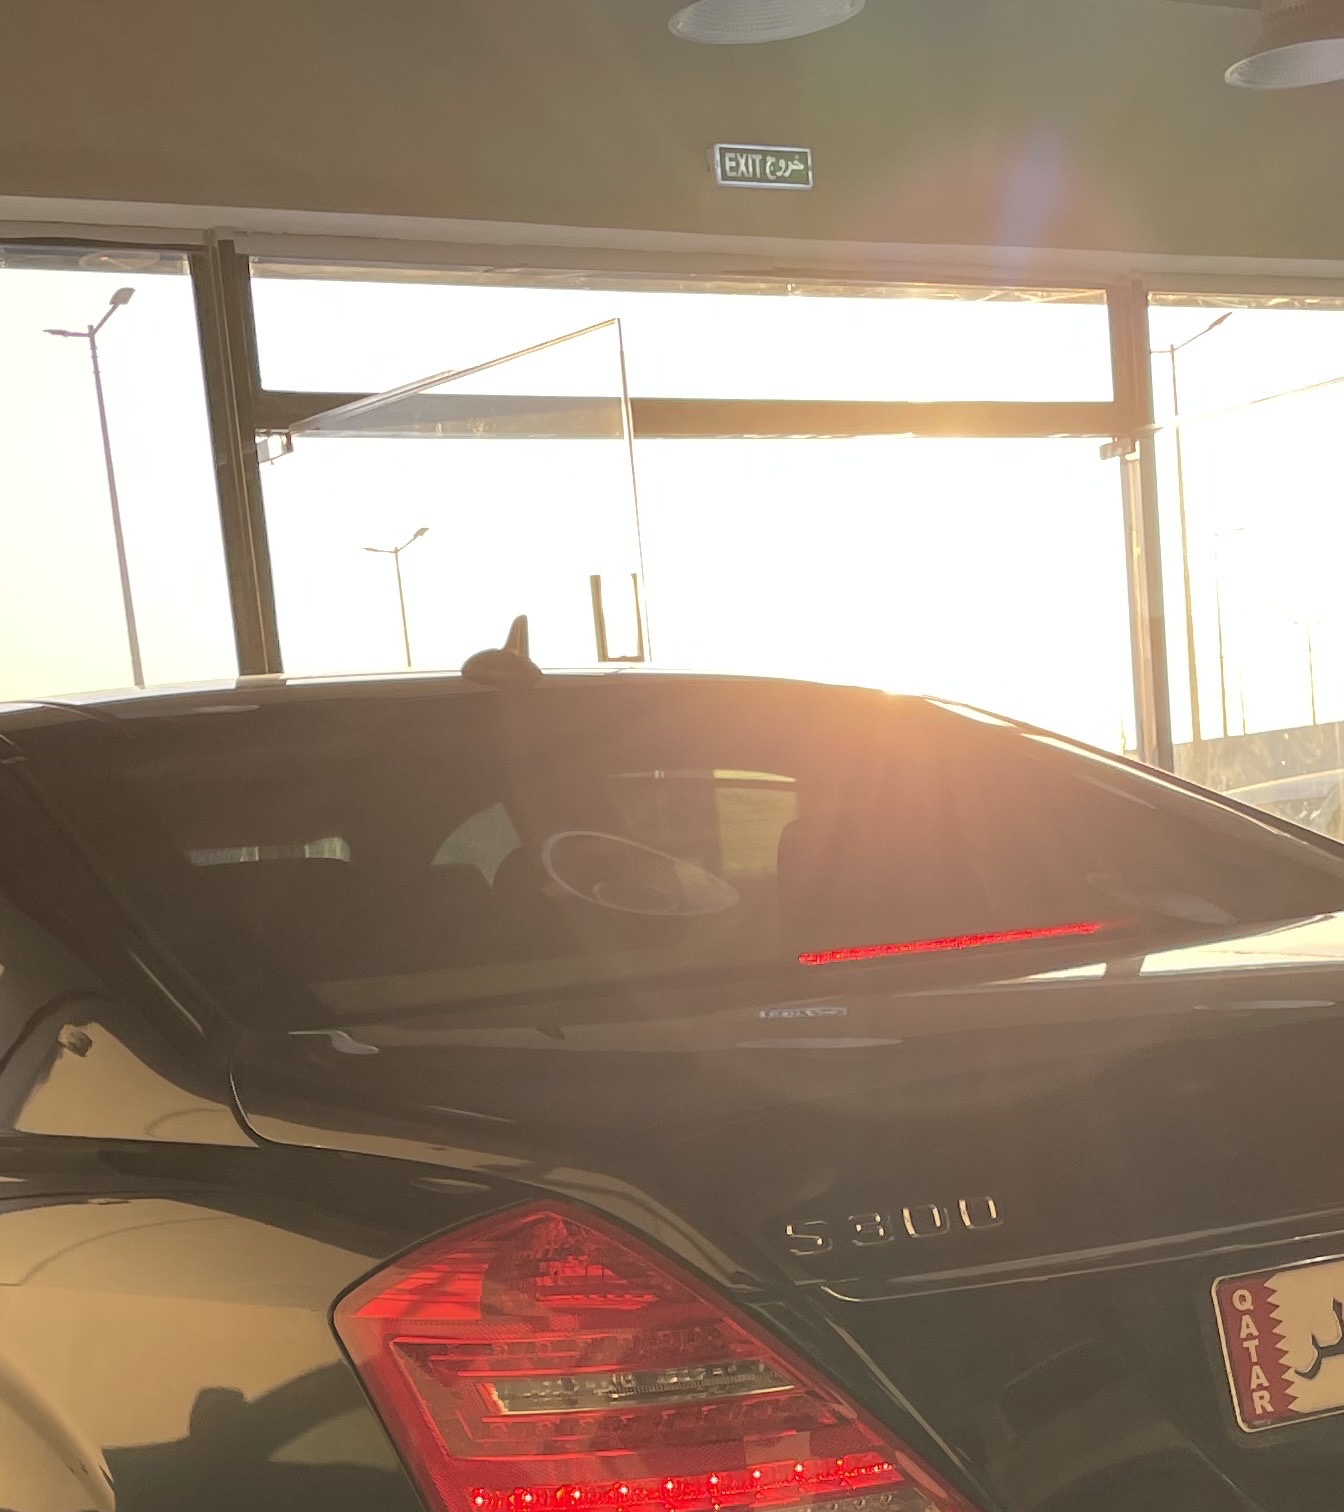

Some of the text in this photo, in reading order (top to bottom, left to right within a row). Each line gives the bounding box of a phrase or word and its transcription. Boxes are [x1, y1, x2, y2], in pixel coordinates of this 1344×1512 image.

[725, 152, 762, 178] EXIT
[765, 154, 805, 180] خروج
[1232, 1289, 1274, 1415] QATAR
